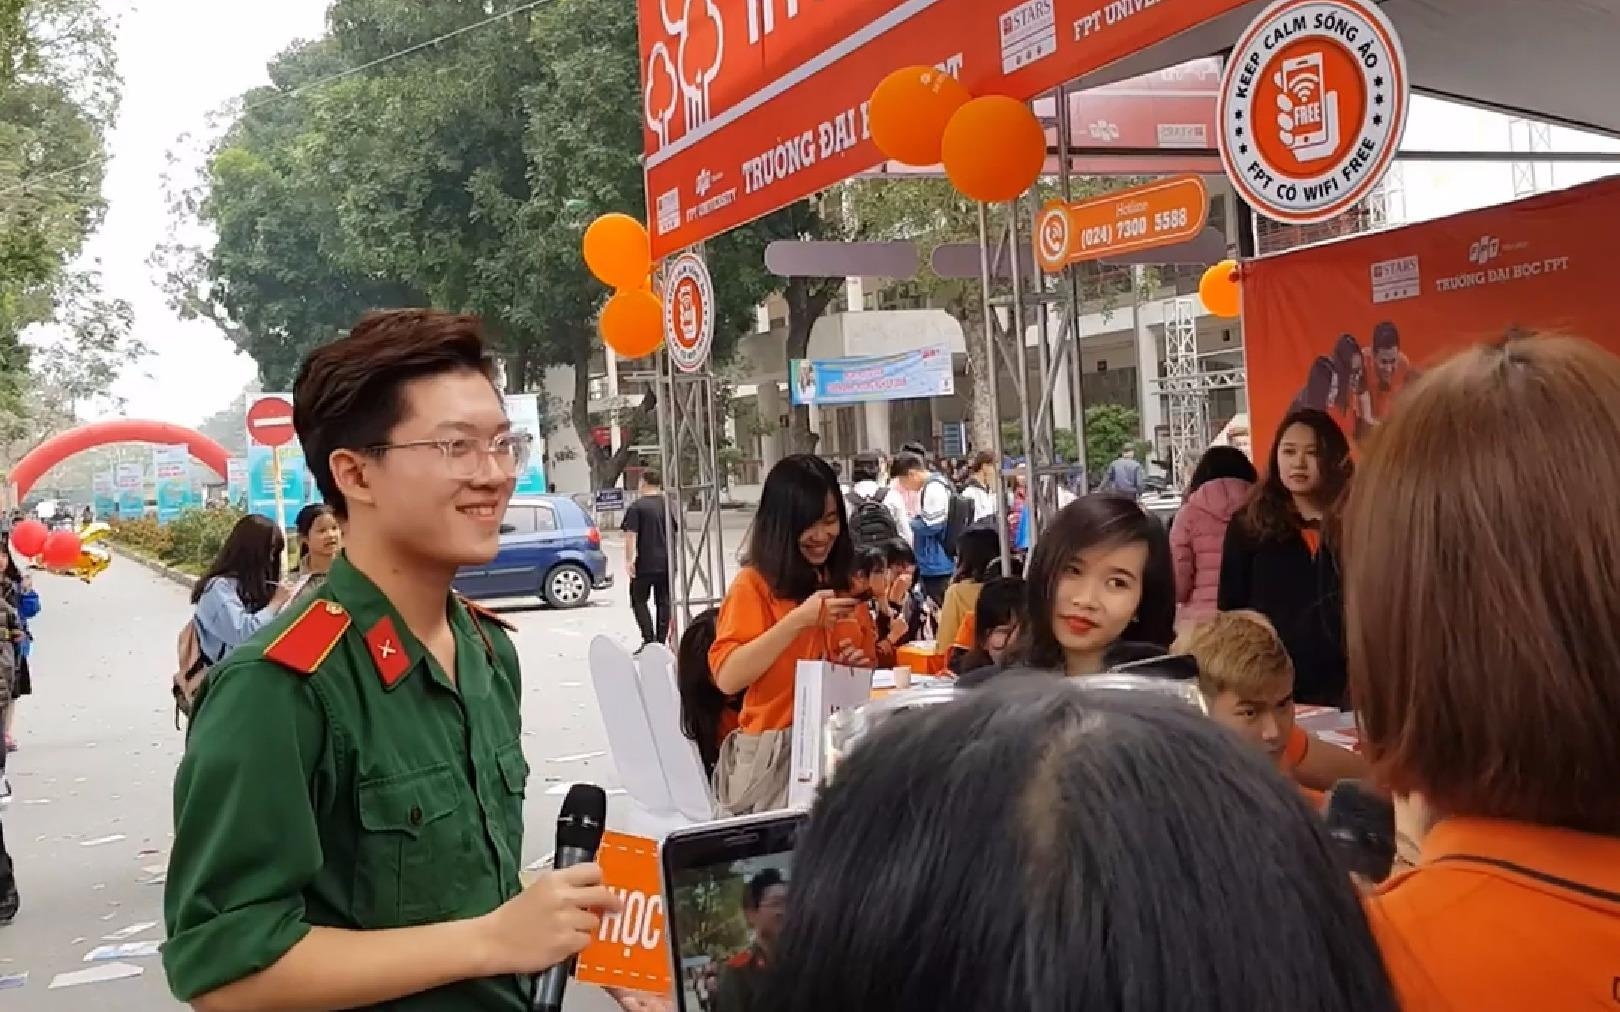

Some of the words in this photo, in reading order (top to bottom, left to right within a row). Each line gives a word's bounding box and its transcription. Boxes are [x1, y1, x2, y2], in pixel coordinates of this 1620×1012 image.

[1013, 0, 1051, 30] STARS
[1073, 9, 1101, 41] FPT
[1104, 0, 1160, 25] UNIV
[1235, 51, 1260, 99] KEEP
[1264, 16, 1308, 50] CALM
[1313, 10, 1359, 42] SỐNG
[818, 108, 857, 159] ĐẠI
[1294, 102, 1321, 126] FREE
[1247, 161, 1275, 190] FPT
[1276, 182, 1297, 201] CÓ
[1303, 177, 1339, 201] WIFI
[1342, 136, 1376, 182] FREE
[1081, 224, 1113, 250] (024)
[1116, 216, 1147, 239] 7300
[1544, 256, 1569, 273] FPT
[599, 886, 663, 957] HỌC
